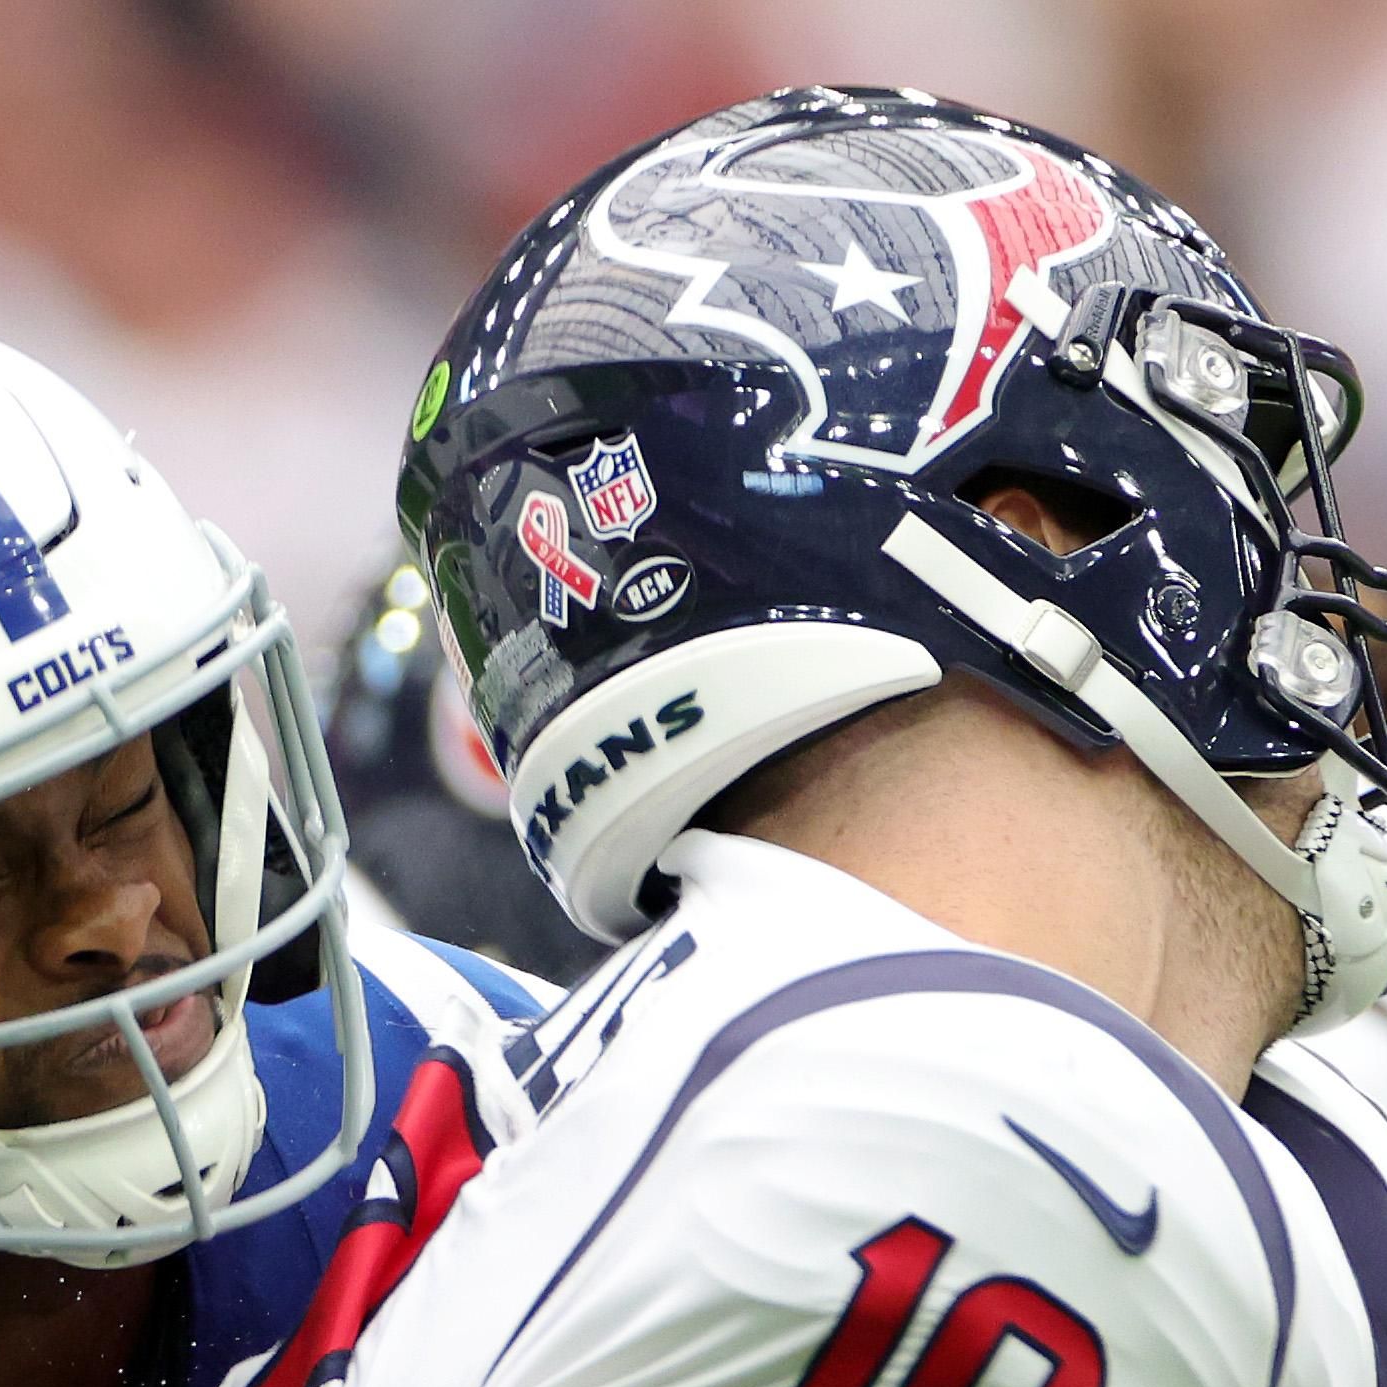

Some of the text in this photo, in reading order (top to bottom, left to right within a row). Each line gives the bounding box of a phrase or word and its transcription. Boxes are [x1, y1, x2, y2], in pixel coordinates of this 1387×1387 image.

[591, 478, 646, 527] NFL
[538, 543, 569, 576] 9/11
[7, 624, 134, 713] COLTS
[526, 689, 704, 882] XANS
